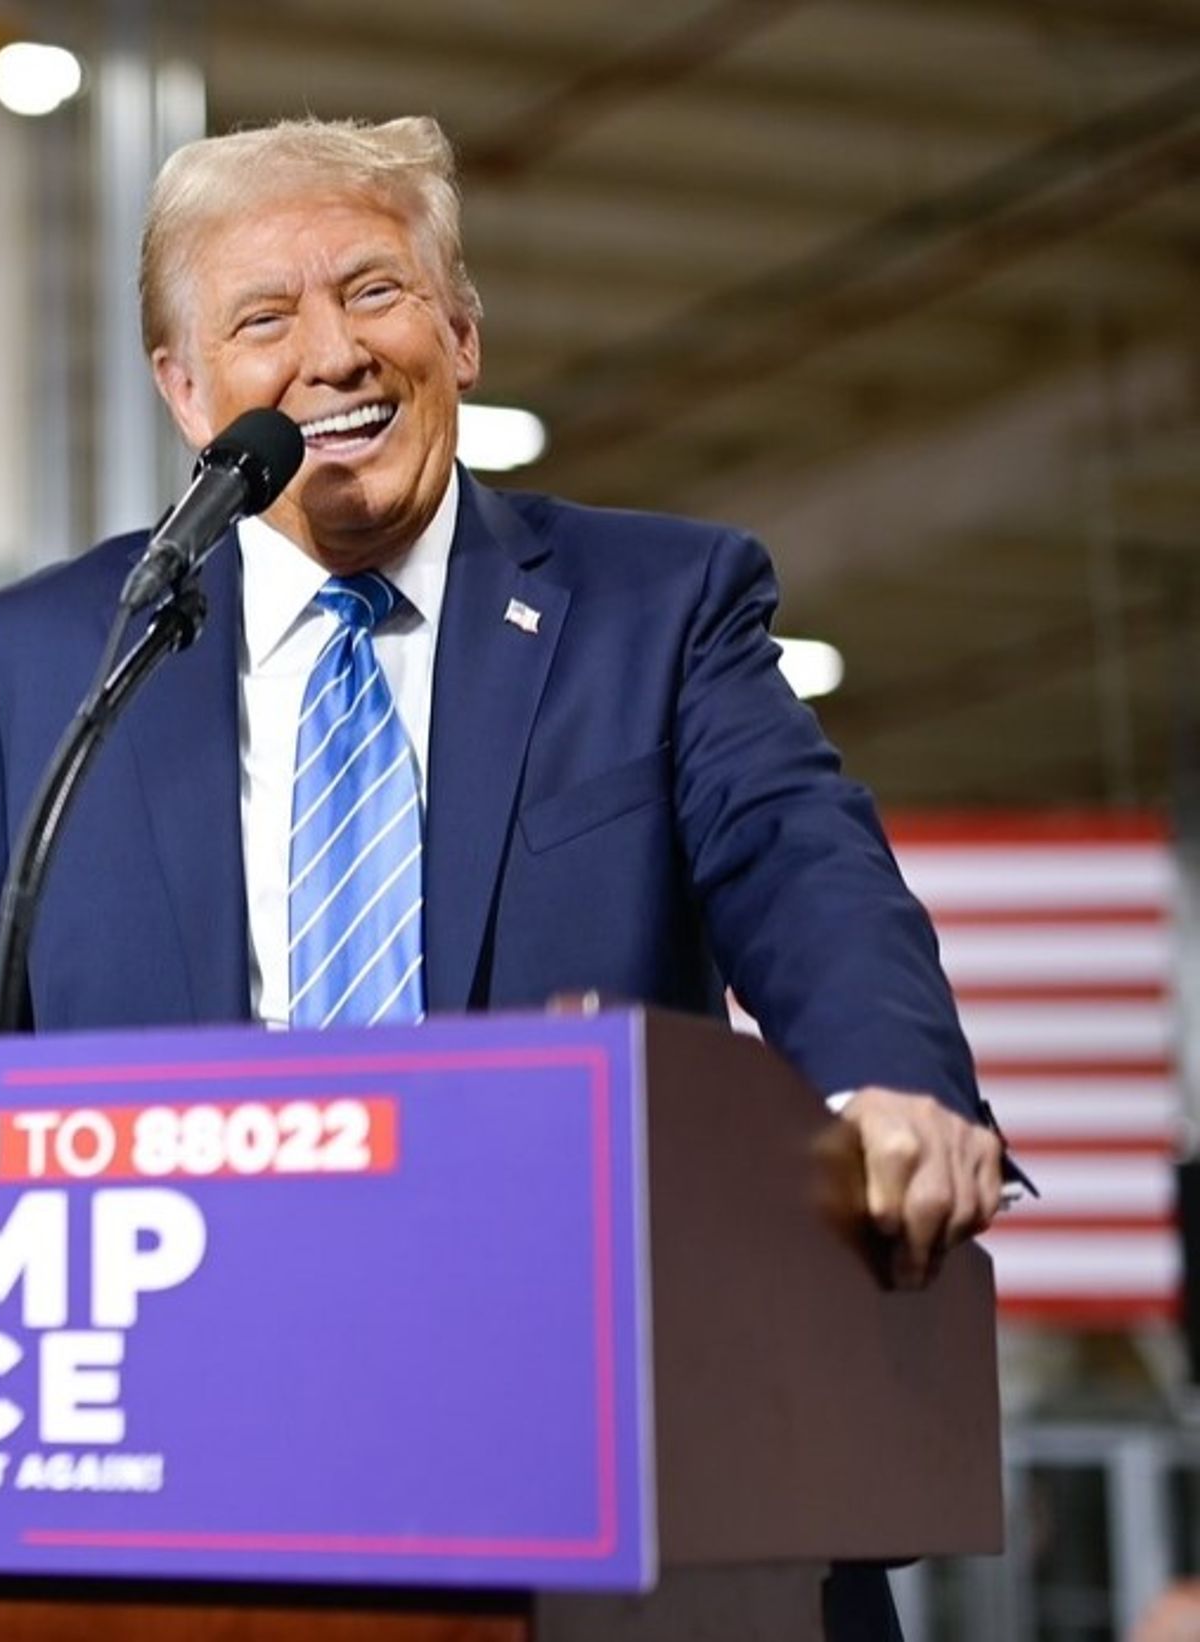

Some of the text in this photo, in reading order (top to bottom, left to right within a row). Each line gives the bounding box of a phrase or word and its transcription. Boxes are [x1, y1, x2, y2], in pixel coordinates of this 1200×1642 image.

[14, 1111, 116, 1176] TO
[133, 1100, 369, 1175] 88022
[15, 1455, 164, 1492] AGAIN!
